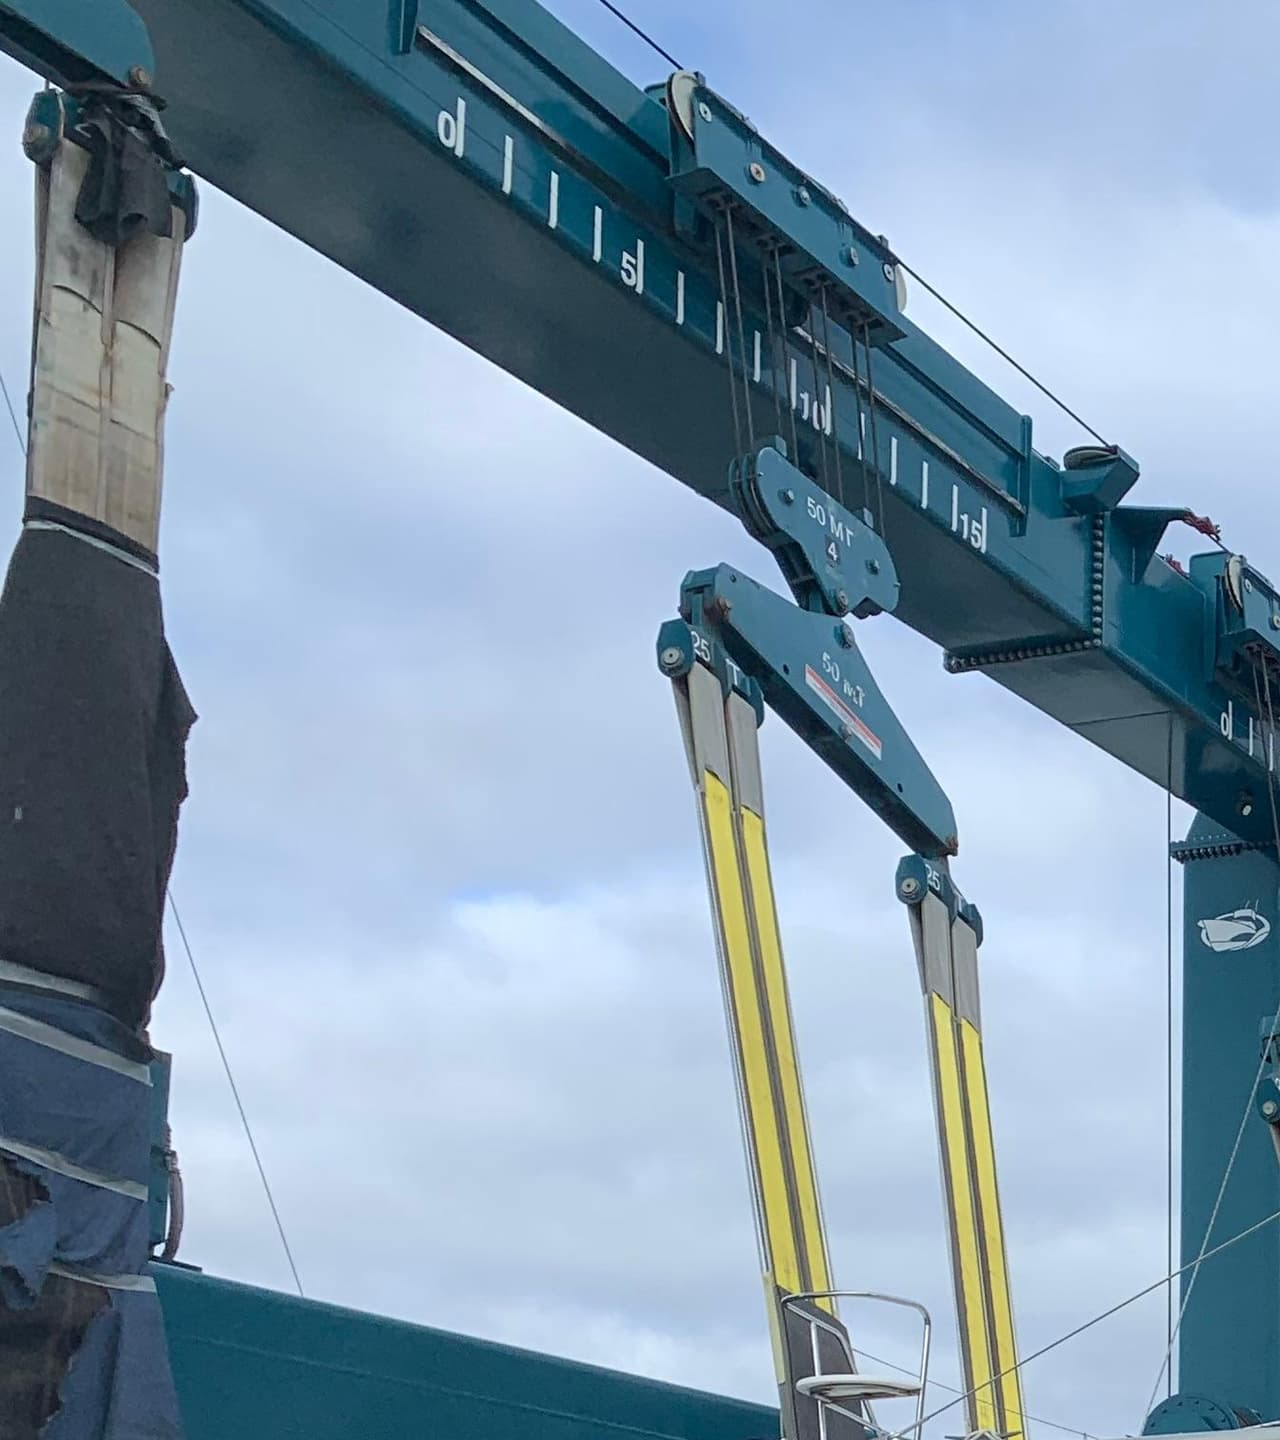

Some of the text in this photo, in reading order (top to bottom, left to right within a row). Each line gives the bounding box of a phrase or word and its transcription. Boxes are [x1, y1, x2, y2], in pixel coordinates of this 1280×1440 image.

[620, 250, 637, 287] 5
[960, 513, 982, 549] 15
[807, 496, 854, 547] 50 MT
[828, 541, 838, 561] 4
[822, 651, 866, 708] 50 MT
